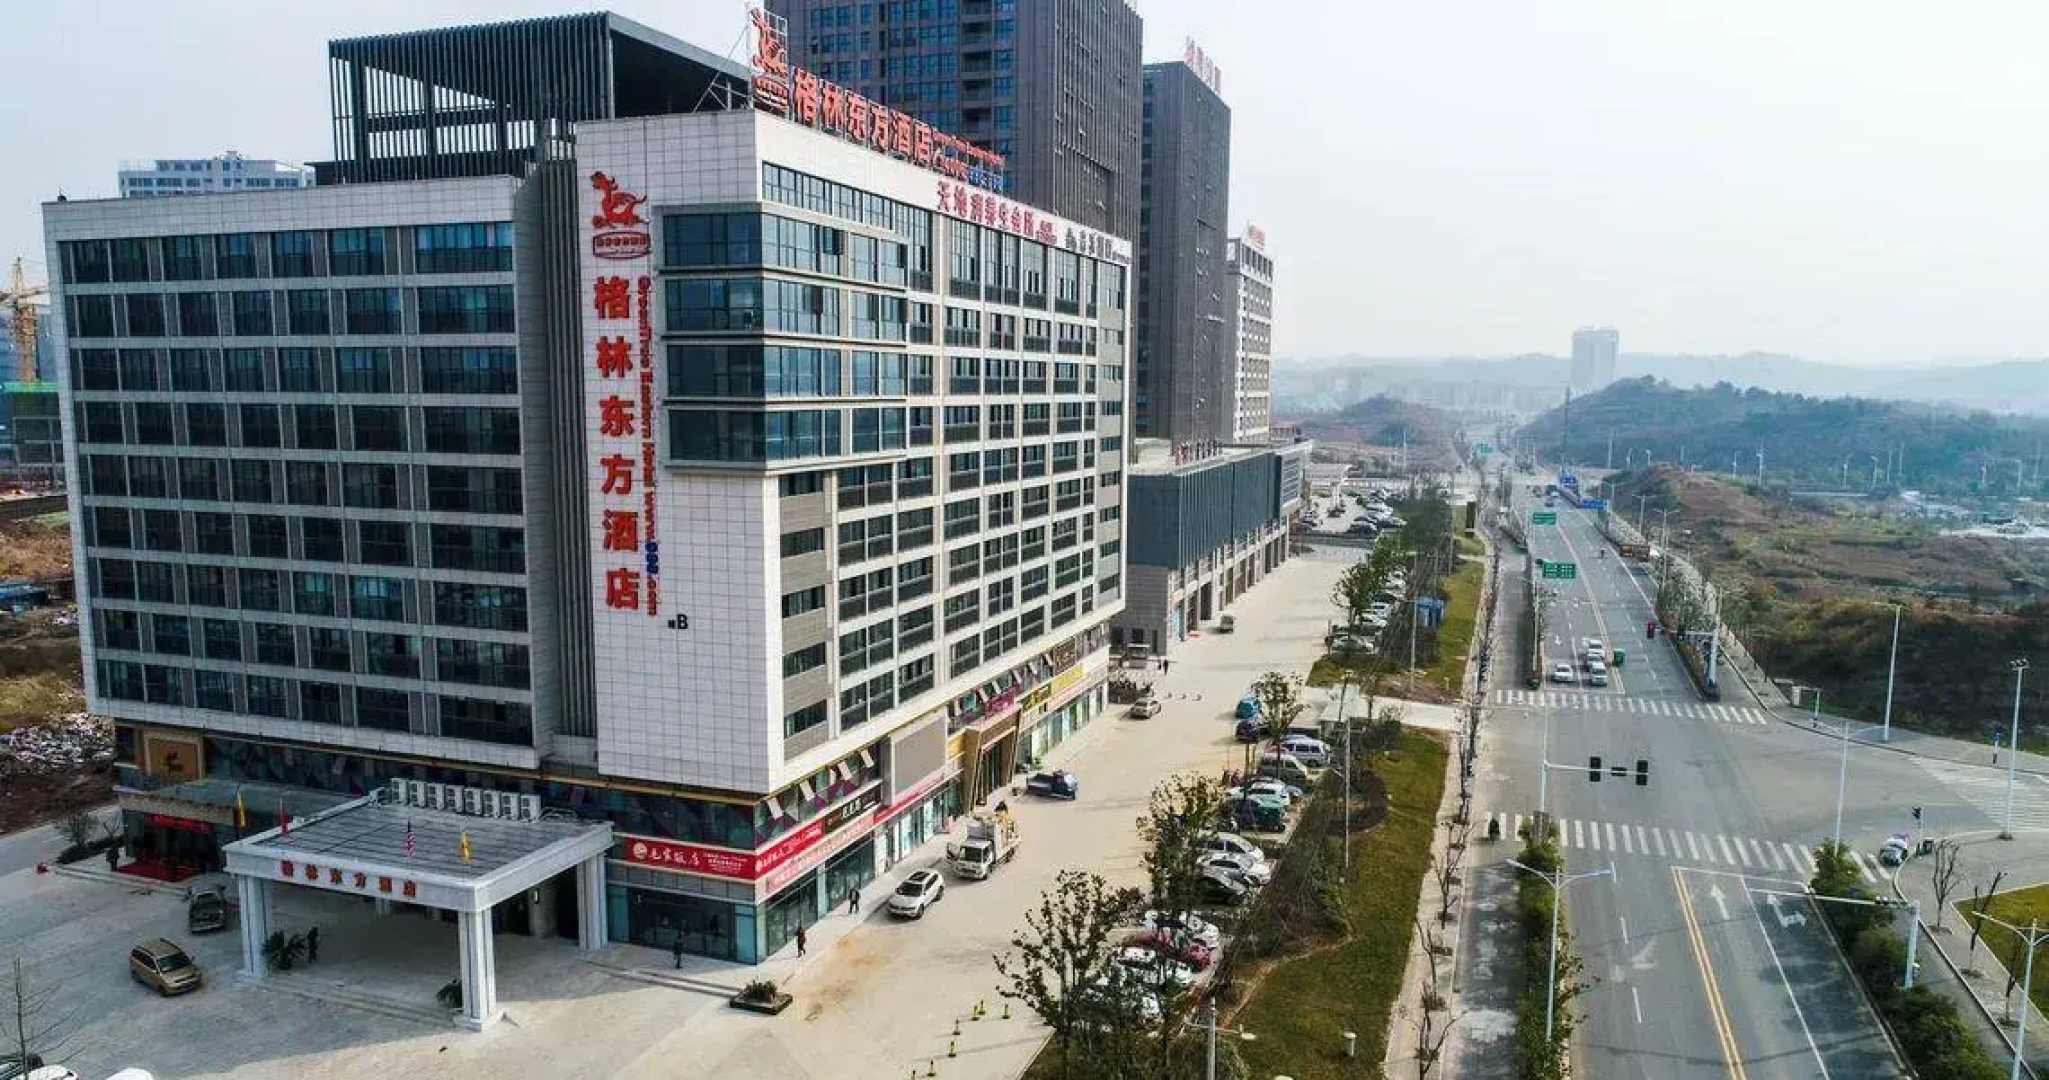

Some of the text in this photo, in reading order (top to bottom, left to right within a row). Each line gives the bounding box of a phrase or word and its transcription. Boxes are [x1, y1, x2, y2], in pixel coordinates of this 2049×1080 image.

[793, 67, 931, 165] 格林东方酒店
[593, 275, 640, 610] 格林东方酒店
